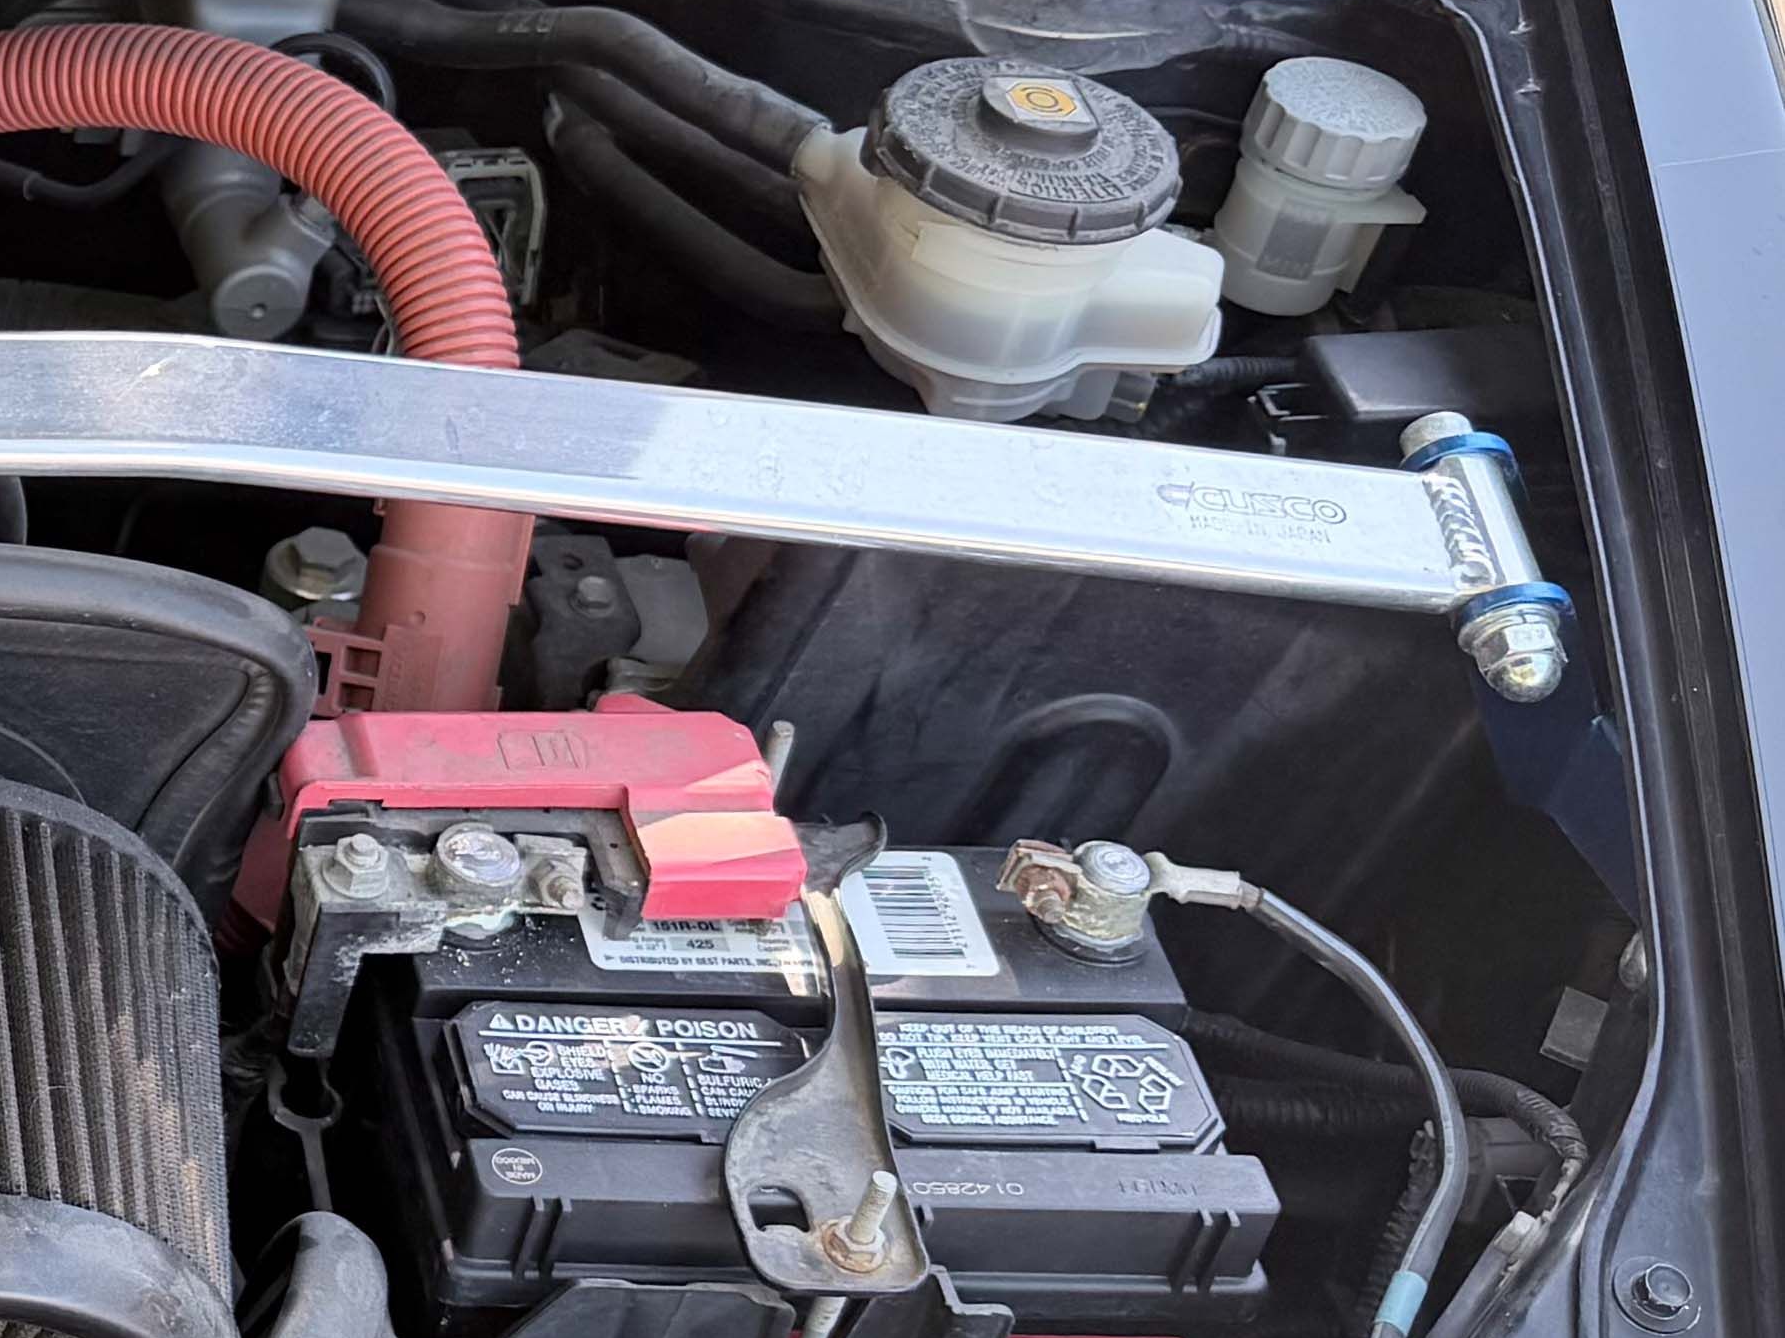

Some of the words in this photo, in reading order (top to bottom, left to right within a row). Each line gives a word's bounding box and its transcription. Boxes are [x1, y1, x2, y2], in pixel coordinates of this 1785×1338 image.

[1193, 486, 1347, 525] CUSCO
[686, 940, 714, 950] 425
[515, 1015, 626, 1034] DANGER
[657, 1020, 758, 1038] POISON
[899, 1023, 929, 1033] KEEP
[931, 1023, 955, 1034] OUT
[958, 1024, 976, 1034] OF
[979, 1024, 1002, 1035] THE
[1004, 1025, 1040, 1035] REACH
[1043, 1025, 1059, 1035] OF
[557, 1044, 606, 1057] SHIELD
[531, 1067, 606, 1081] EXPLOSIVE
[641, 1072, 665, 1085] NO
[535, 1079, 580, 1092] GASES
[698, 1075, 762, 1088] SULFURIC
